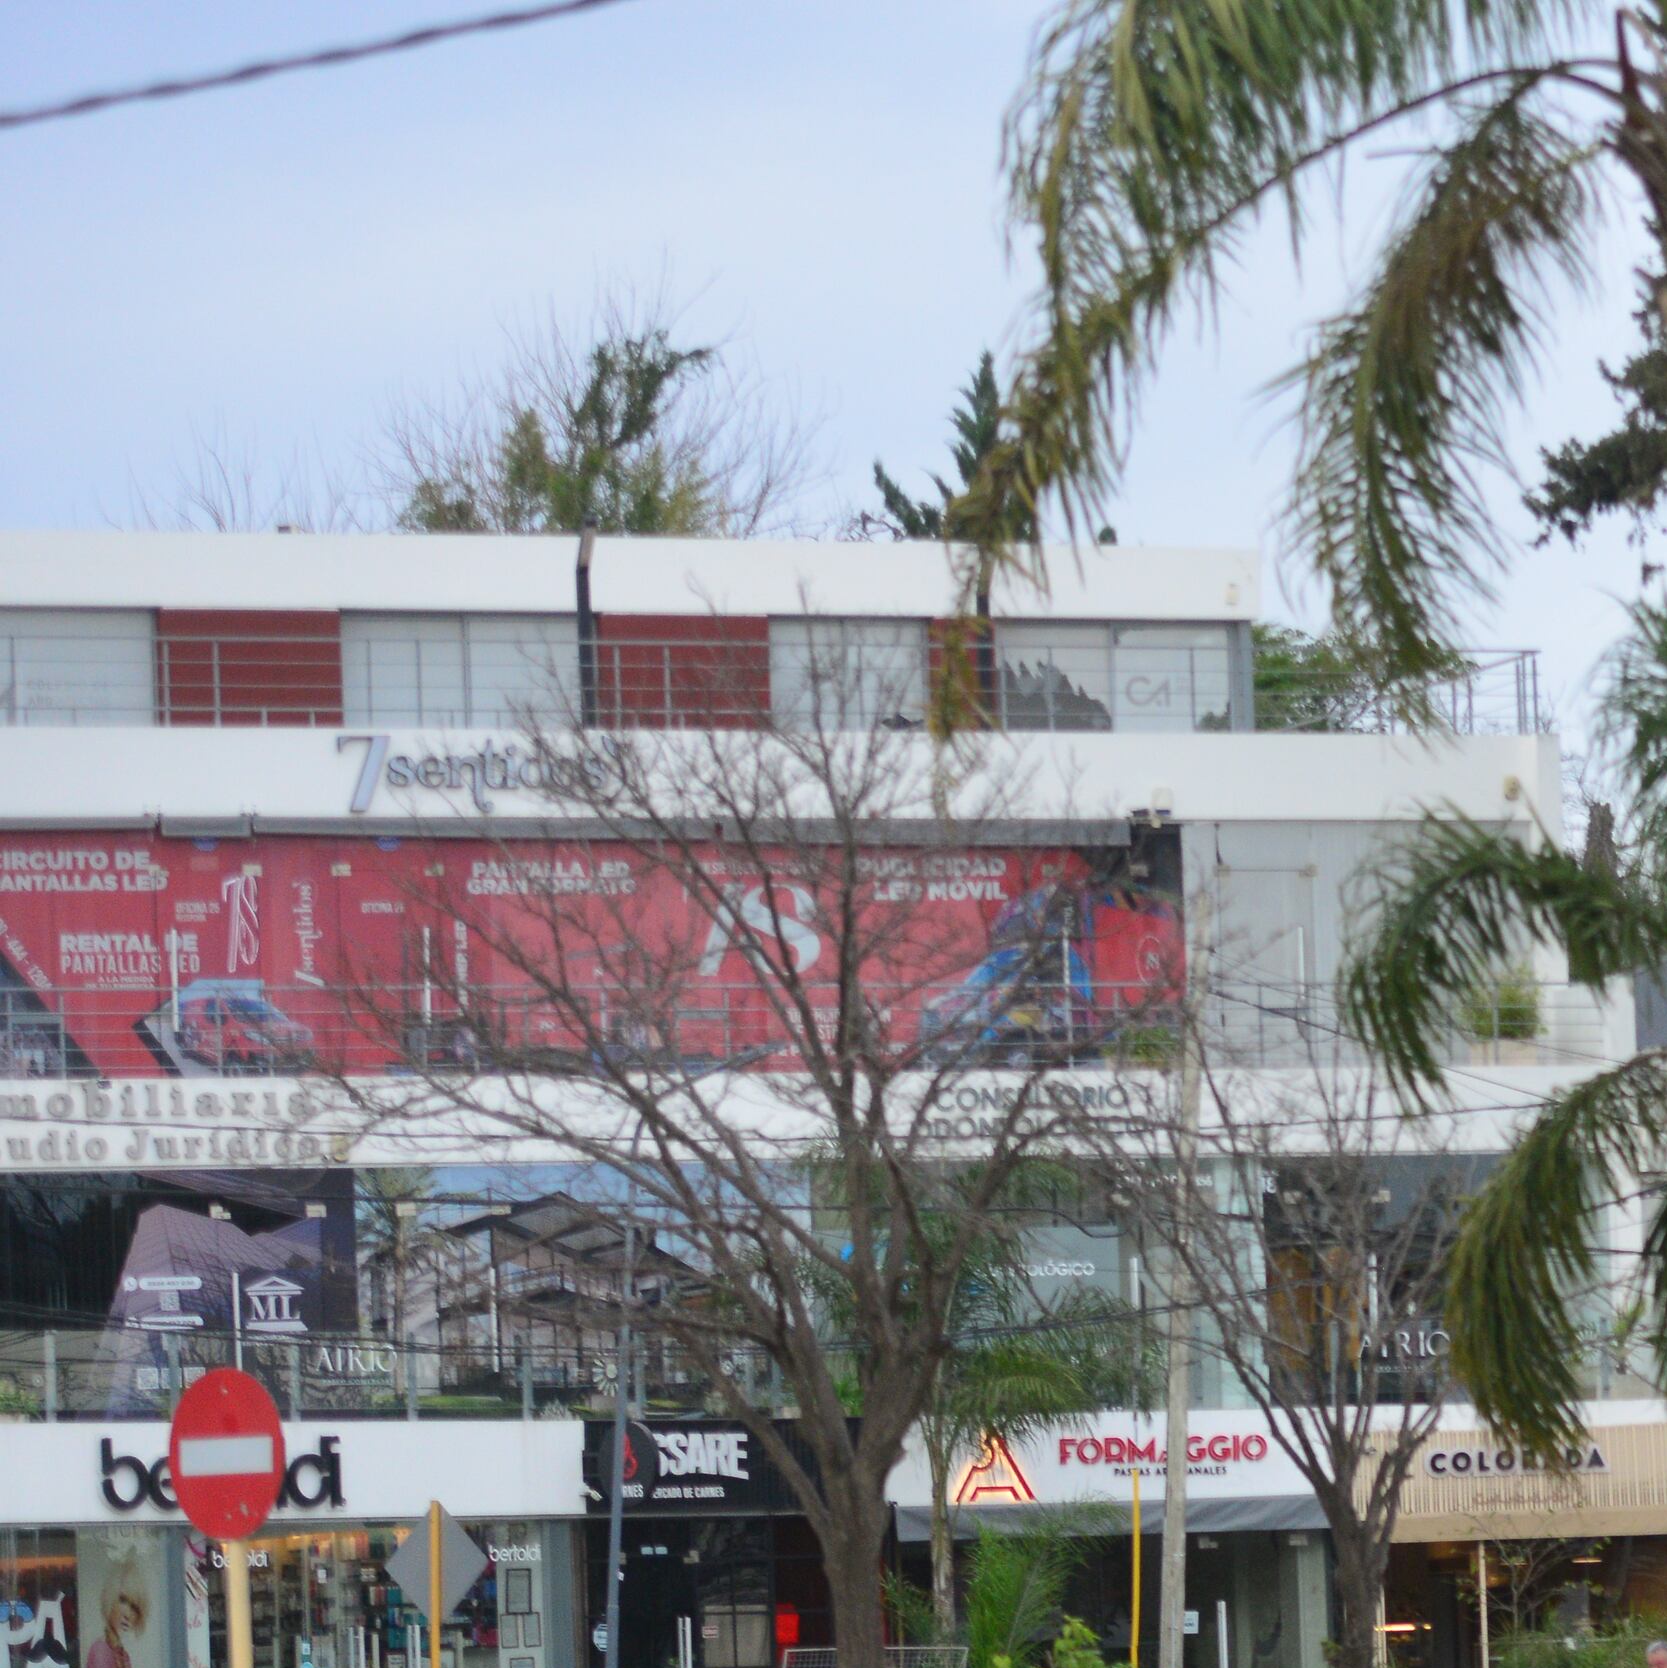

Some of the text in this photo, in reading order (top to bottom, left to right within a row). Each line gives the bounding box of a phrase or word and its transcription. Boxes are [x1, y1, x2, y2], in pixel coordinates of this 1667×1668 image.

[0, 851, 150, 870] IRCUITO DE
[123, 875, 167, 891] LED
[60, 933, 158, 952] RENTAL
[61, 954, 162, 974] PANTALLAS
[1058, 1434, 1269, 1466] FORMGGIO
[1429, 1448, 1605, 1475] COLODA
[1114, 1466, 1228, 1477] PASAS ARANALES
